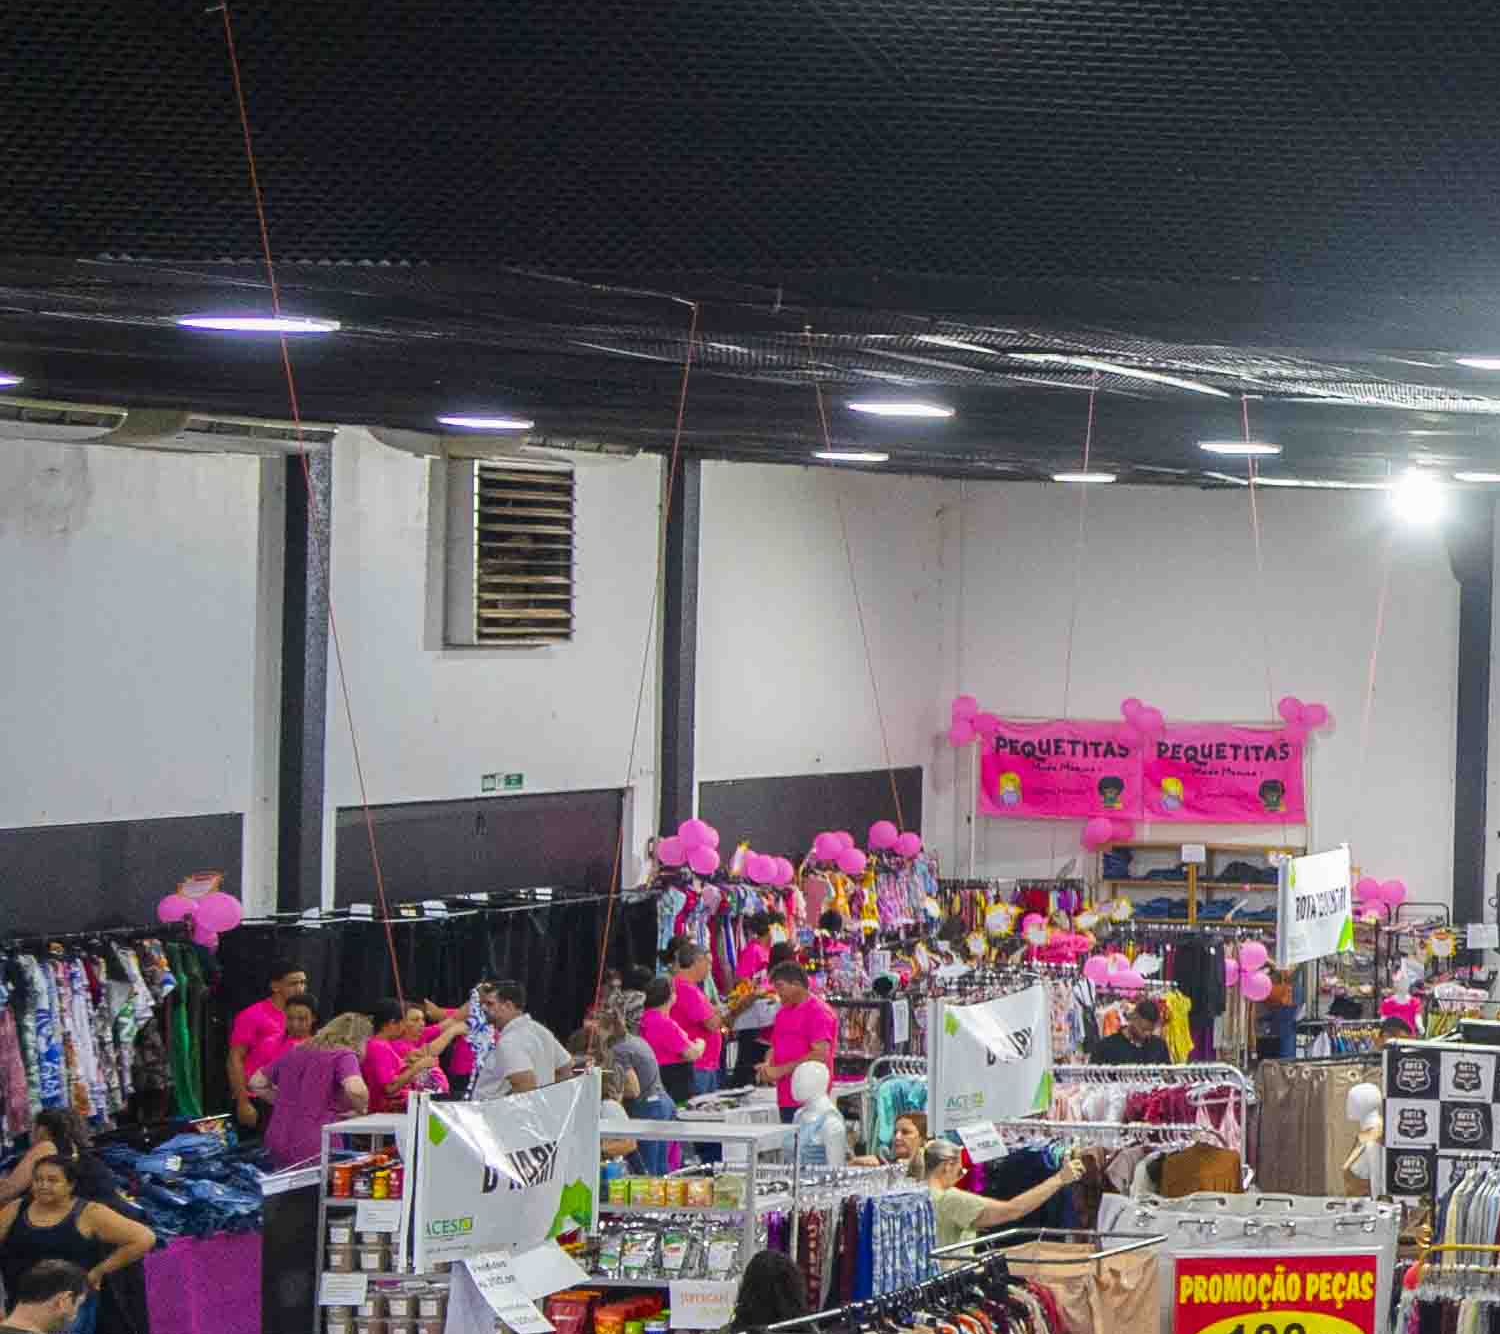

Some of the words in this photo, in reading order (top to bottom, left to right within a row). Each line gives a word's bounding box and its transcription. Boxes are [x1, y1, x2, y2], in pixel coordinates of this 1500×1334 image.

[994, 735, 1130, 762] PEQUETITAS
[1156, 740, 1290, 766] PEQUETITAS
[1178, 1263, 1301, 1310] PROMOÇÃO
[1304, 1271, 1376, 1309] PEÇAS
